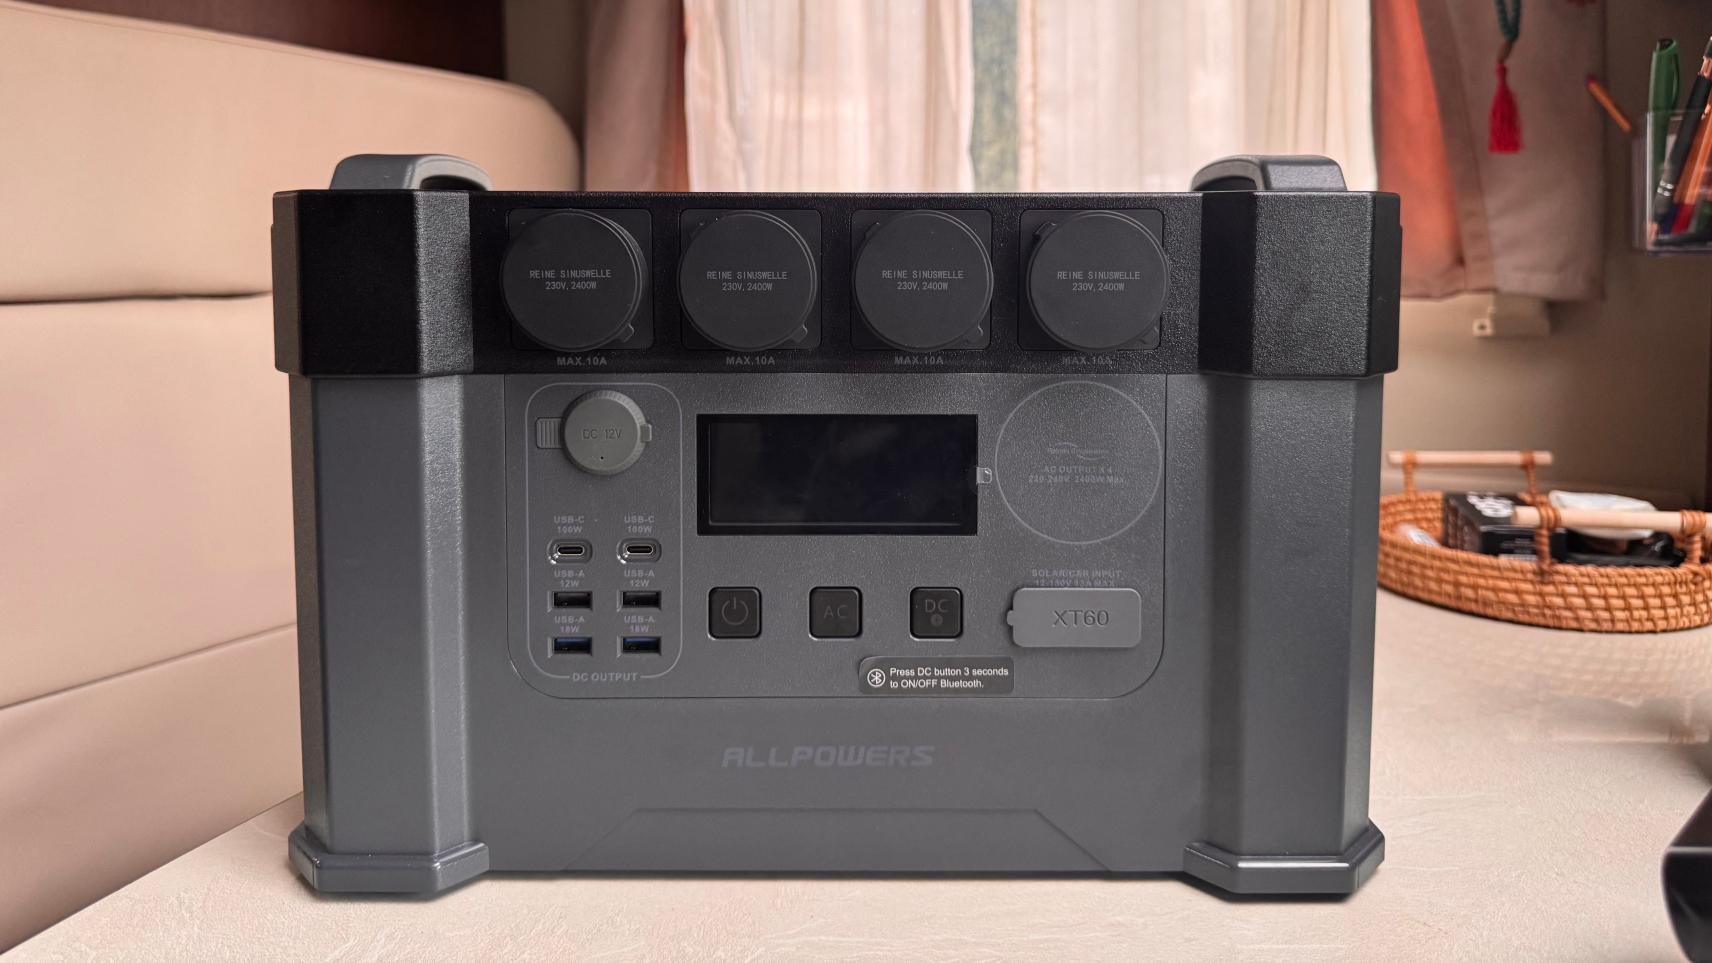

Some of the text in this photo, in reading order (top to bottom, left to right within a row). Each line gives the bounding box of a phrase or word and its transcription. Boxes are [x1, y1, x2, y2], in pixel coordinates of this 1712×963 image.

[529, 270, 612, 279] REINE SINUSWELLE
[706, 271, 788, 280] REINE SINUSWELLE
[881, 270, 964, 279] REINE SINUSWELLE
[1057, 271, 1140, 280] REINE SINUSWELLE
[557, 356, 607, 366] MAX.10A
[726, 356, 775, 366] MAX.10A
[894, 356, 944, 365] MAX.10A
[582, 428, 622, 440] DC 12V
[553, 515, 585, 524] USB-C
[624, 515, 655, 523] USB-C
[627, 525, 652, 533] 100W
[554, 569, 585, 578] USB-A
[624, 569, 655, 577] USB-A
[1091, 569, 1122, 578] INPUT
[560, 580, 580, 588] 12W
[630, 579, 650, 587] 12W
[925, 599, 948, 613] DC
[823, 604, 848, 619] AC
[554, 615, 585, 624] USB-A
[624, 615, 655, 623] USB-A
[1053, 609, 1109, 627] XT60
[560, 625, 580, 633] 18W
[889, 667, 1009, 676] Press DC button 3 seconds
[572, 672, 639, 682] DC OUTPUT
[889, 679, 984, 689] to ON/OFF Bluetooth.
[721, 745, 936, 769] ALLPOWERS
